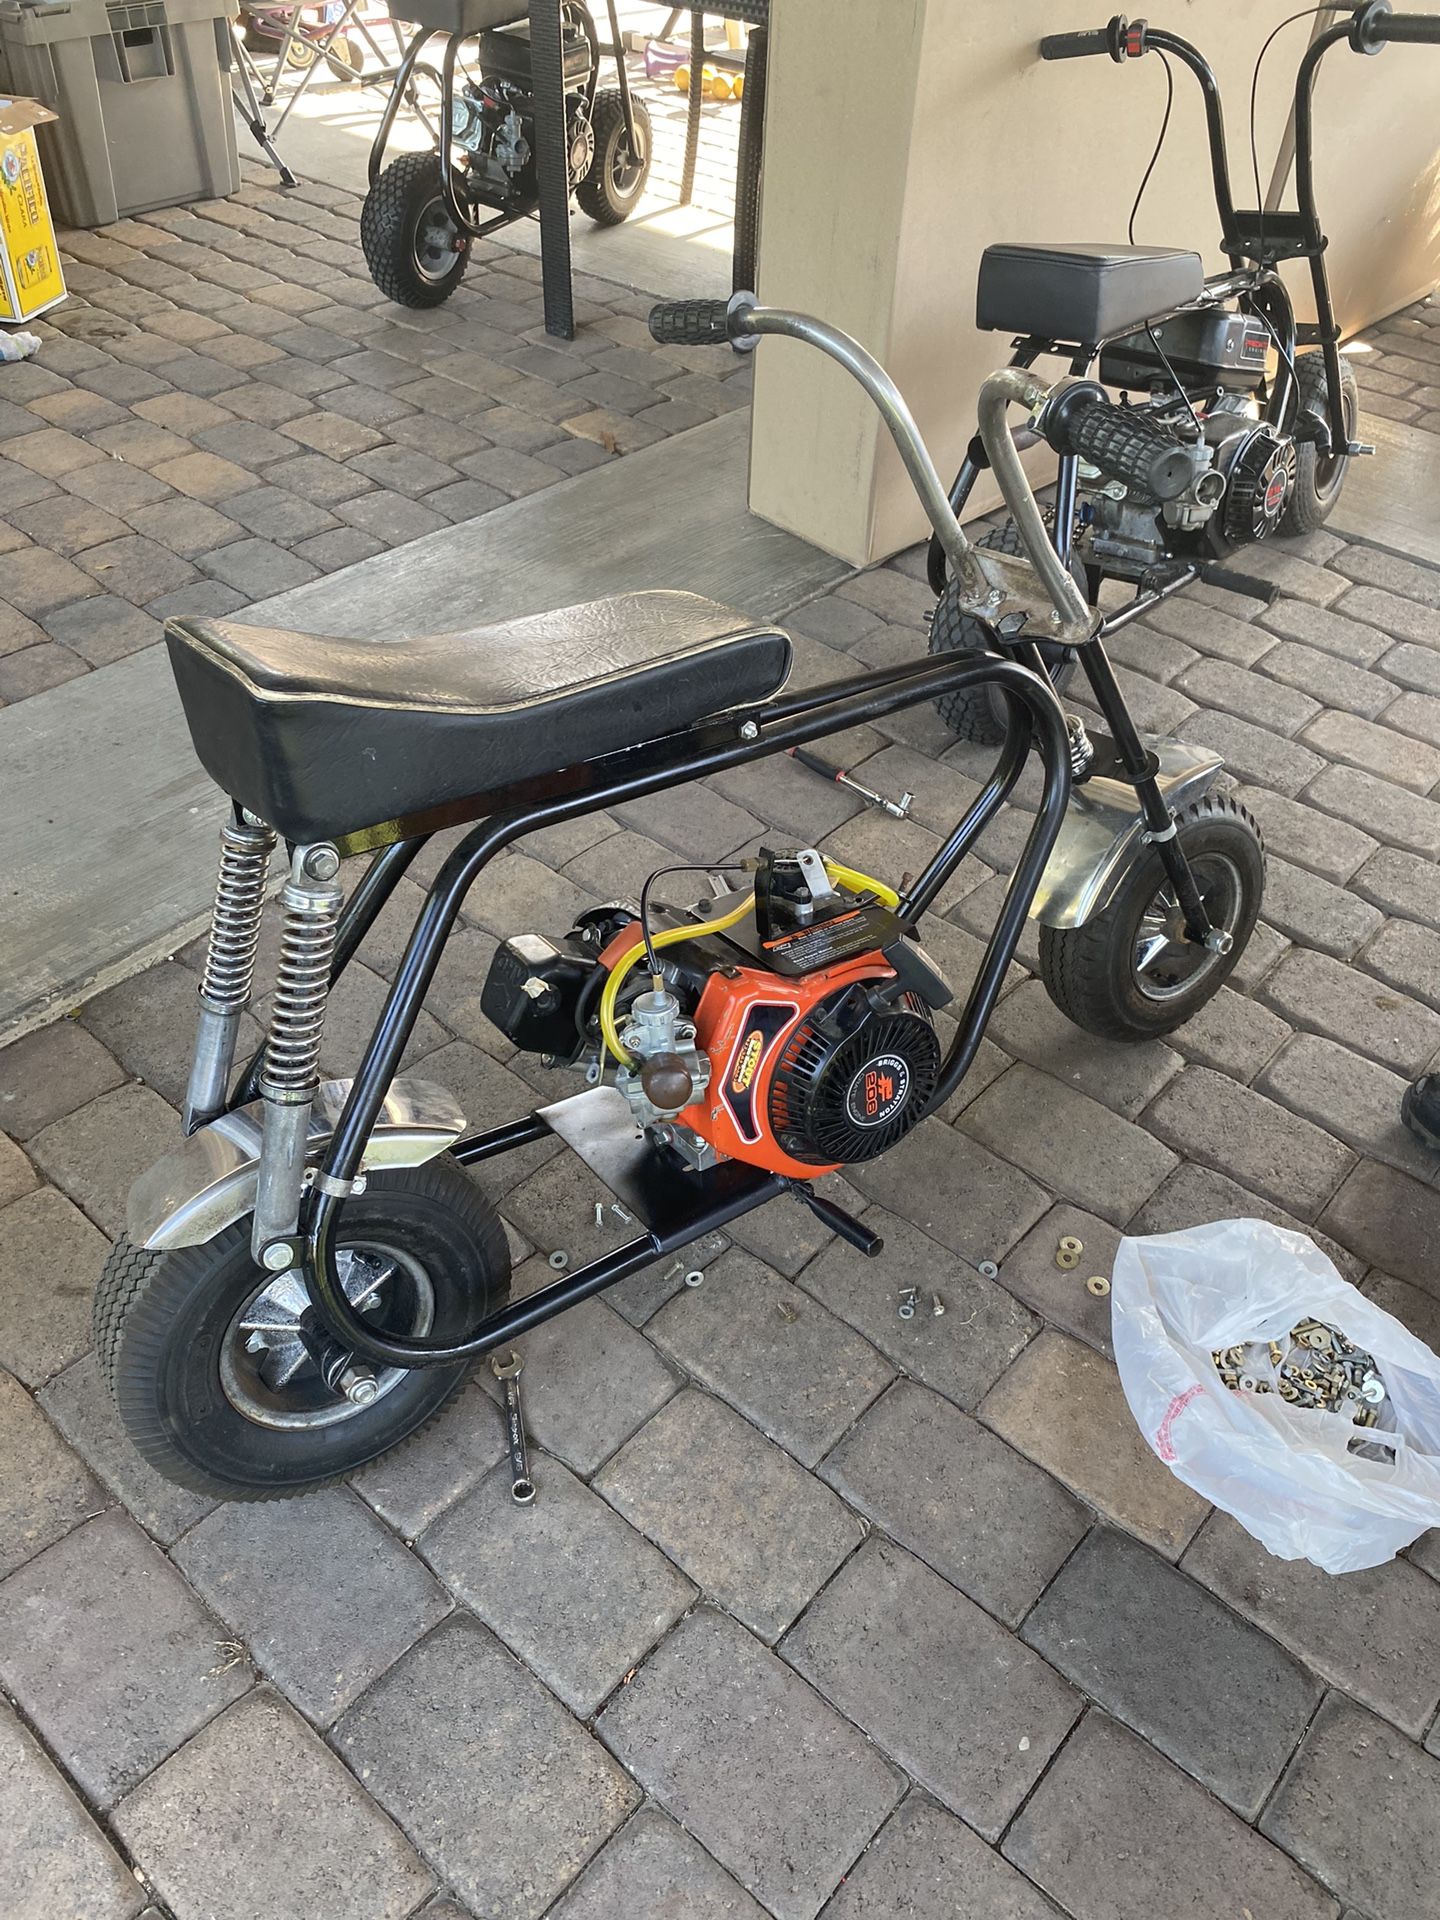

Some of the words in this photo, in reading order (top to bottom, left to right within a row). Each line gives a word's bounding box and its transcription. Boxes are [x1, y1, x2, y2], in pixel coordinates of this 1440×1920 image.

[876, 1058, 902, 1073] BRIGGS
[865, 1070, 878, 1116] 206
[879, 1078, 906, 1118] STRATTON
